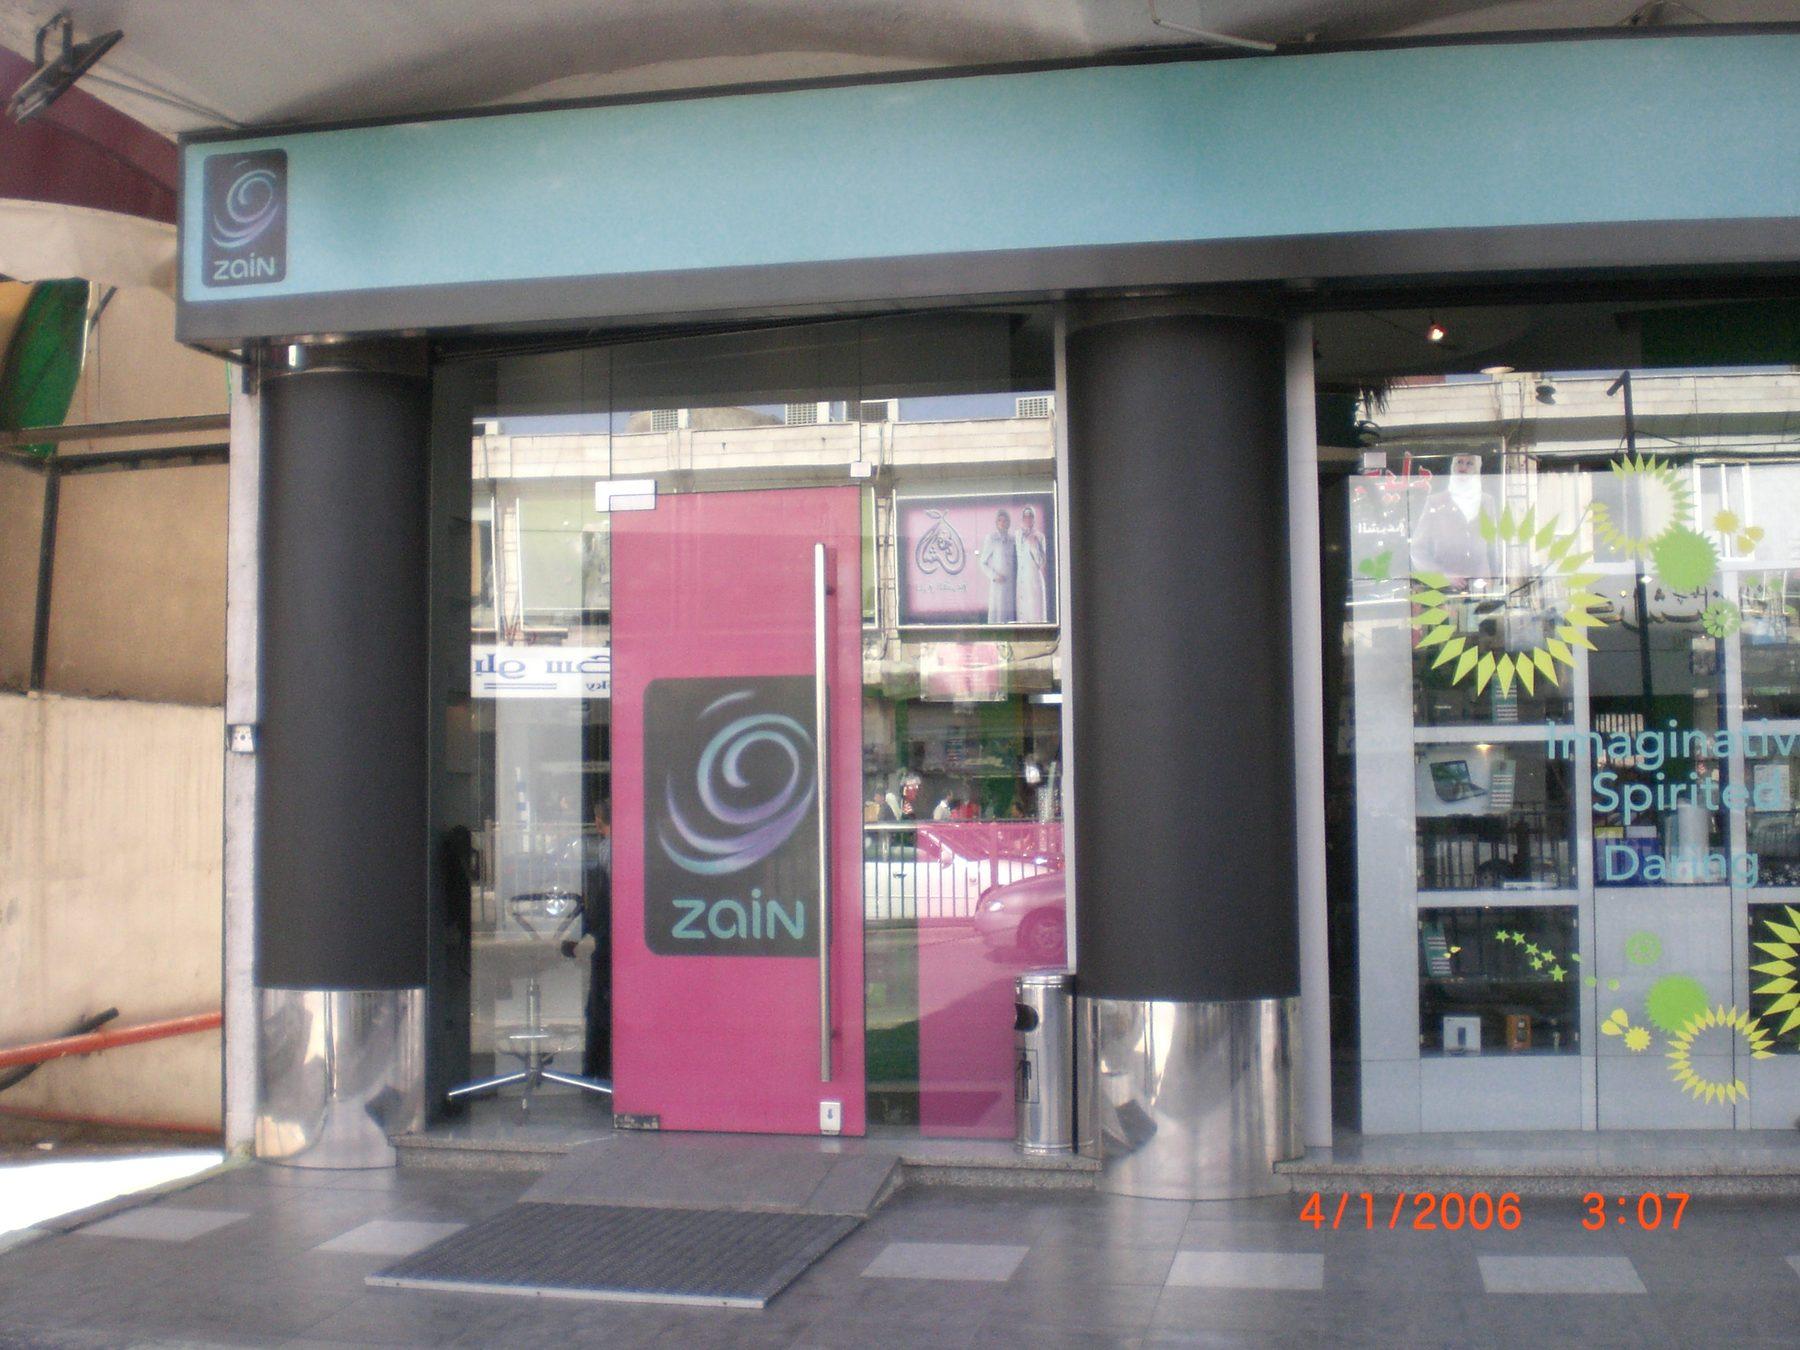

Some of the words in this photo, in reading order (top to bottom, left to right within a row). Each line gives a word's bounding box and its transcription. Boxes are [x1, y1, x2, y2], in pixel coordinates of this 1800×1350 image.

[1547, 718, 1800, 771] Imaginativ
[1592, 768, 1781, 826] Spirited
[1605, 844, 1759, 889] Daring
